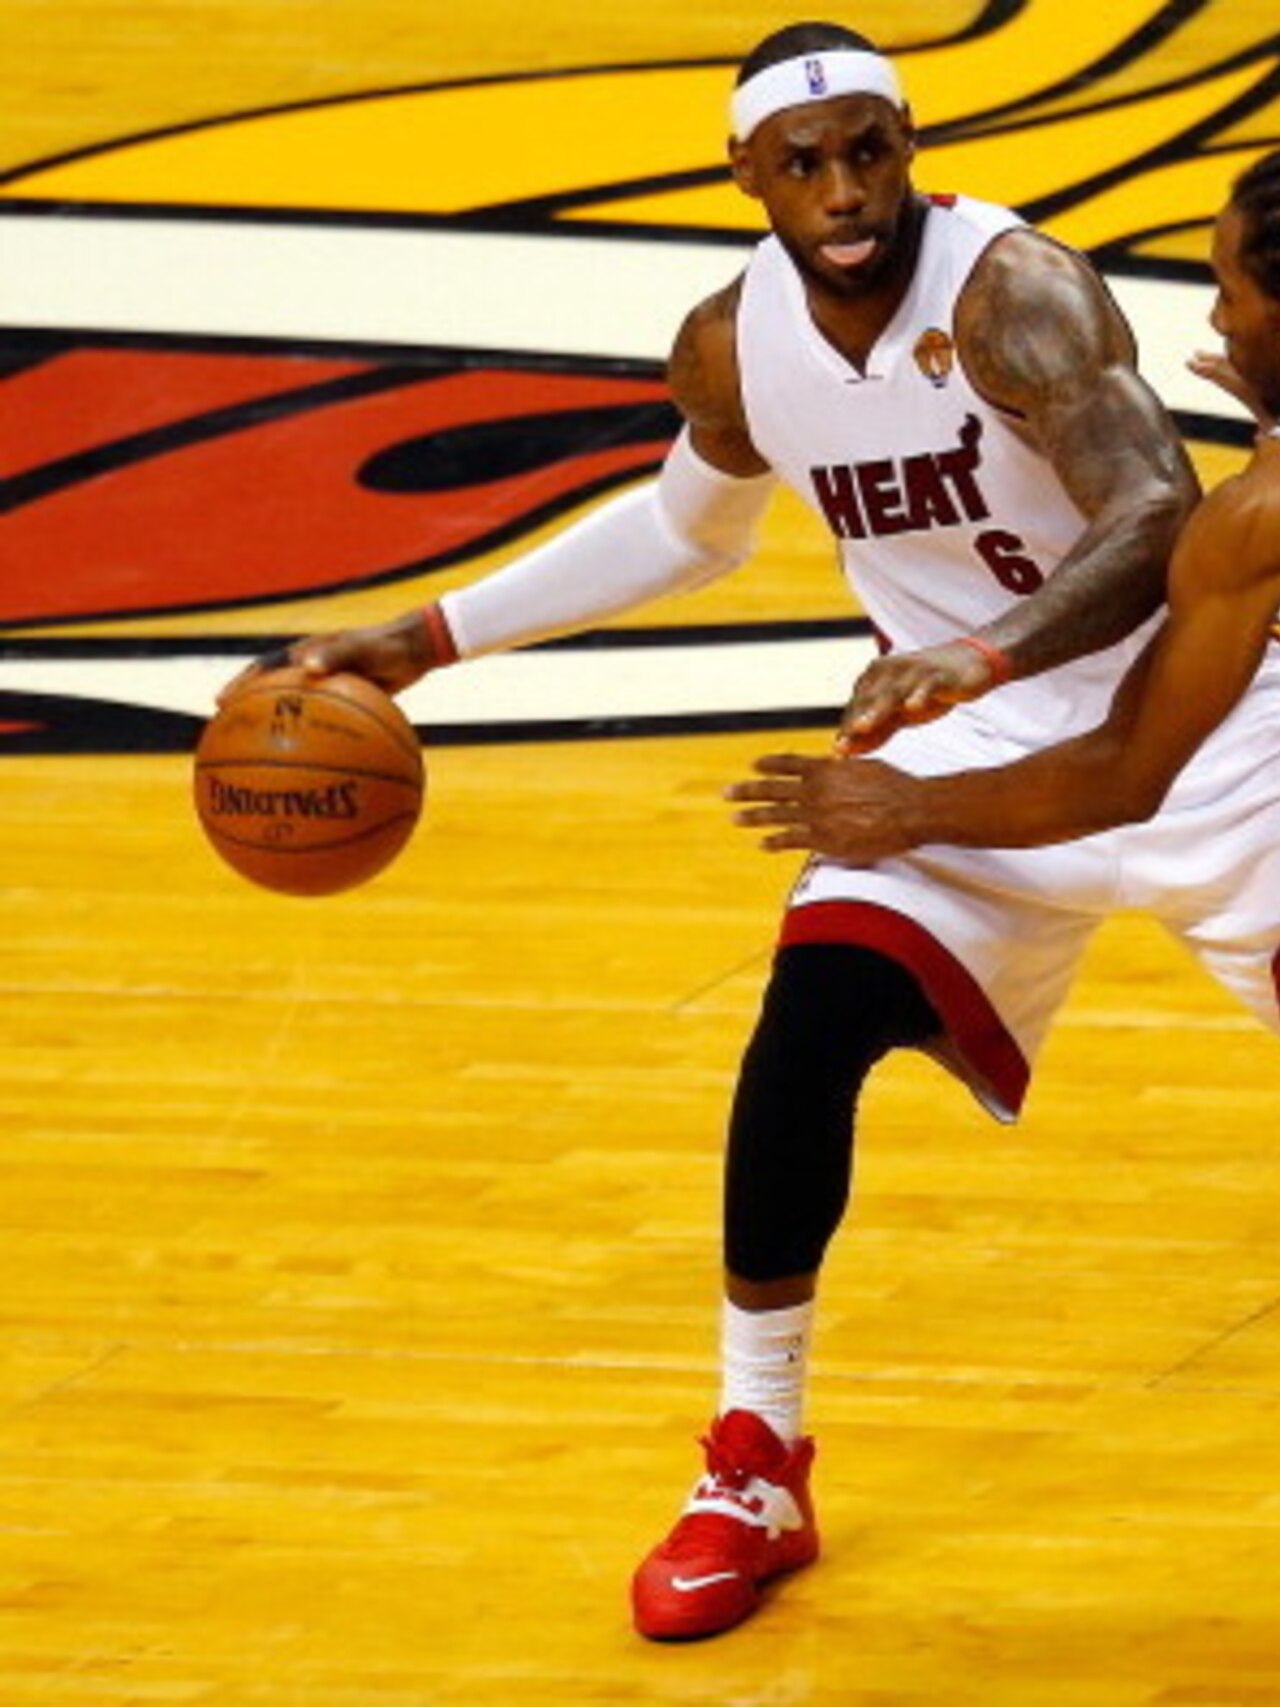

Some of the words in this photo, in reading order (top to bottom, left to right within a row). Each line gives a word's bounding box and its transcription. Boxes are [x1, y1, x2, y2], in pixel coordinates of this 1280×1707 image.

[809, 413, 991, 539] HEAT
[973, 529, 1044, 595] 6
[208, 775, 358, 819] SPALDING
